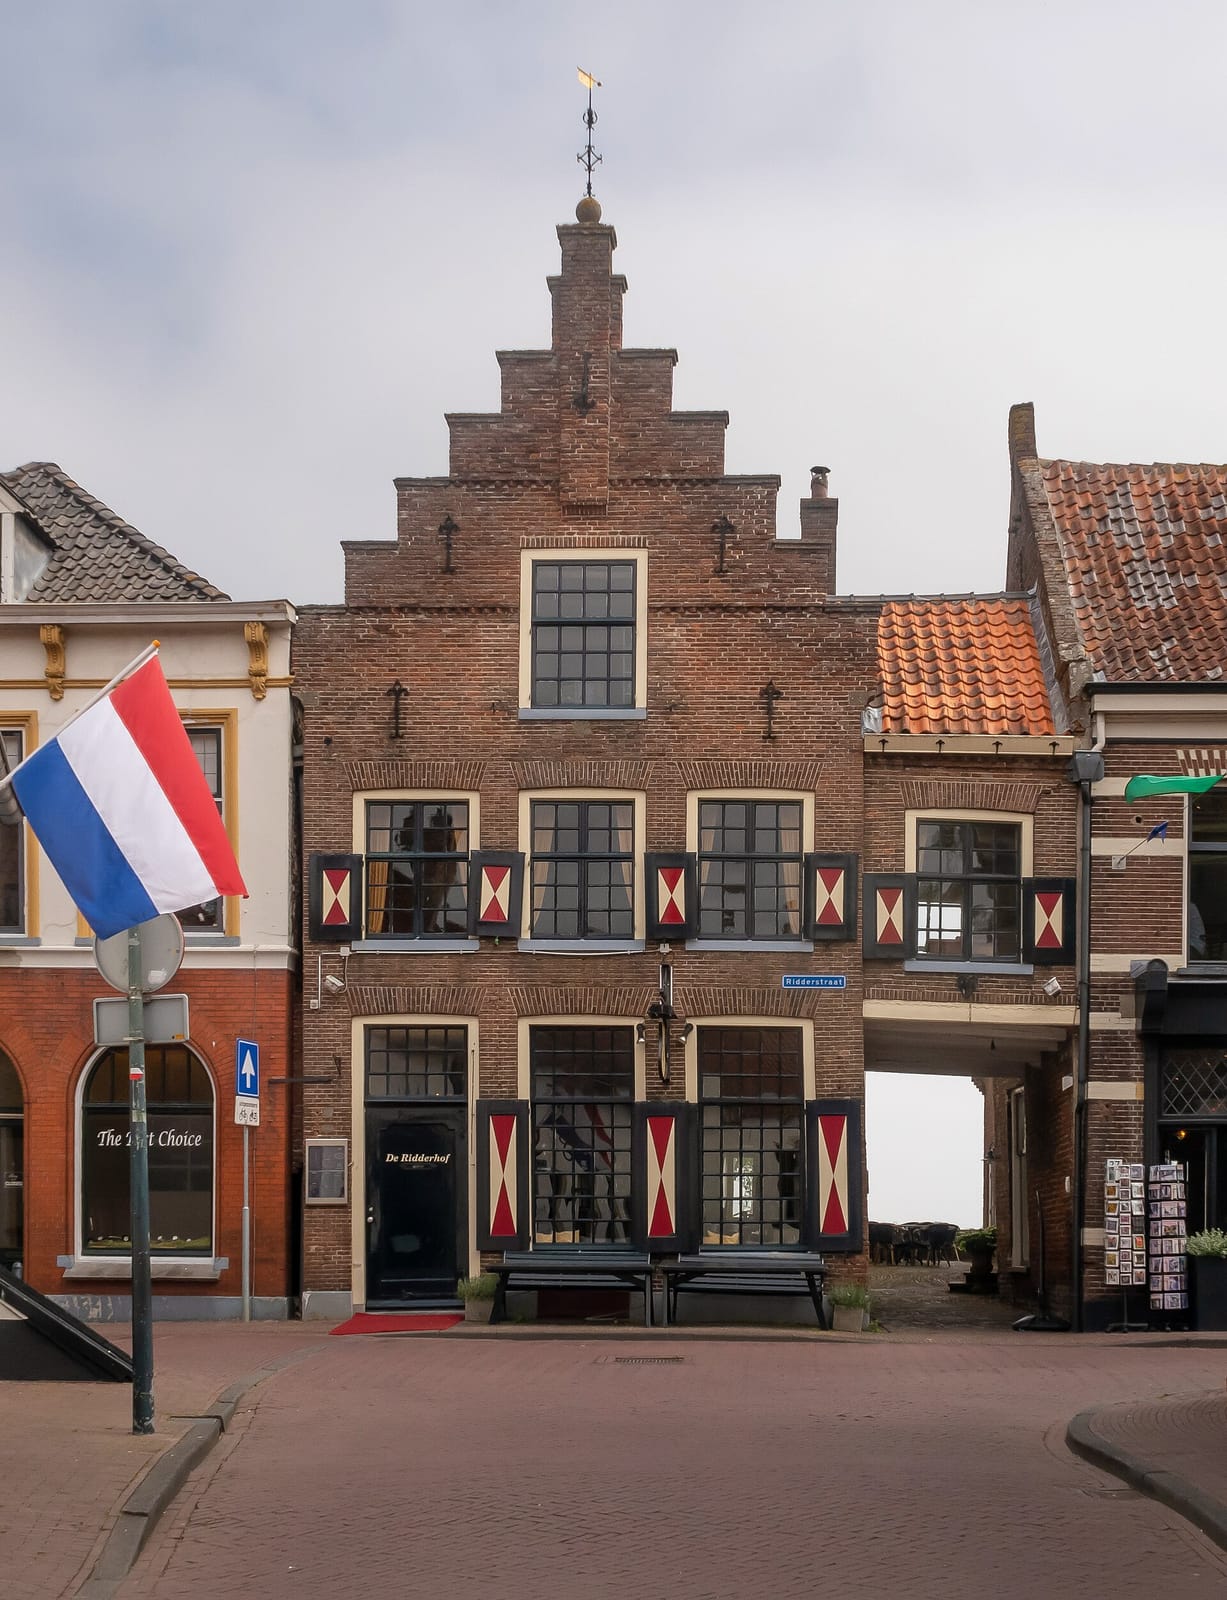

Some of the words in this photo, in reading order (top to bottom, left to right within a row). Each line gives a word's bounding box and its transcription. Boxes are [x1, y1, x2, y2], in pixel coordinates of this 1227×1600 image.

[786, 978, 843, 986] Ridderstraat
[97, 1128, 122, 1146] The
[158, 1128, 202, 1147] Choice
[385, 1153, 399, 1162] De
[401, 1153, 451, 1164] Ridderhof
